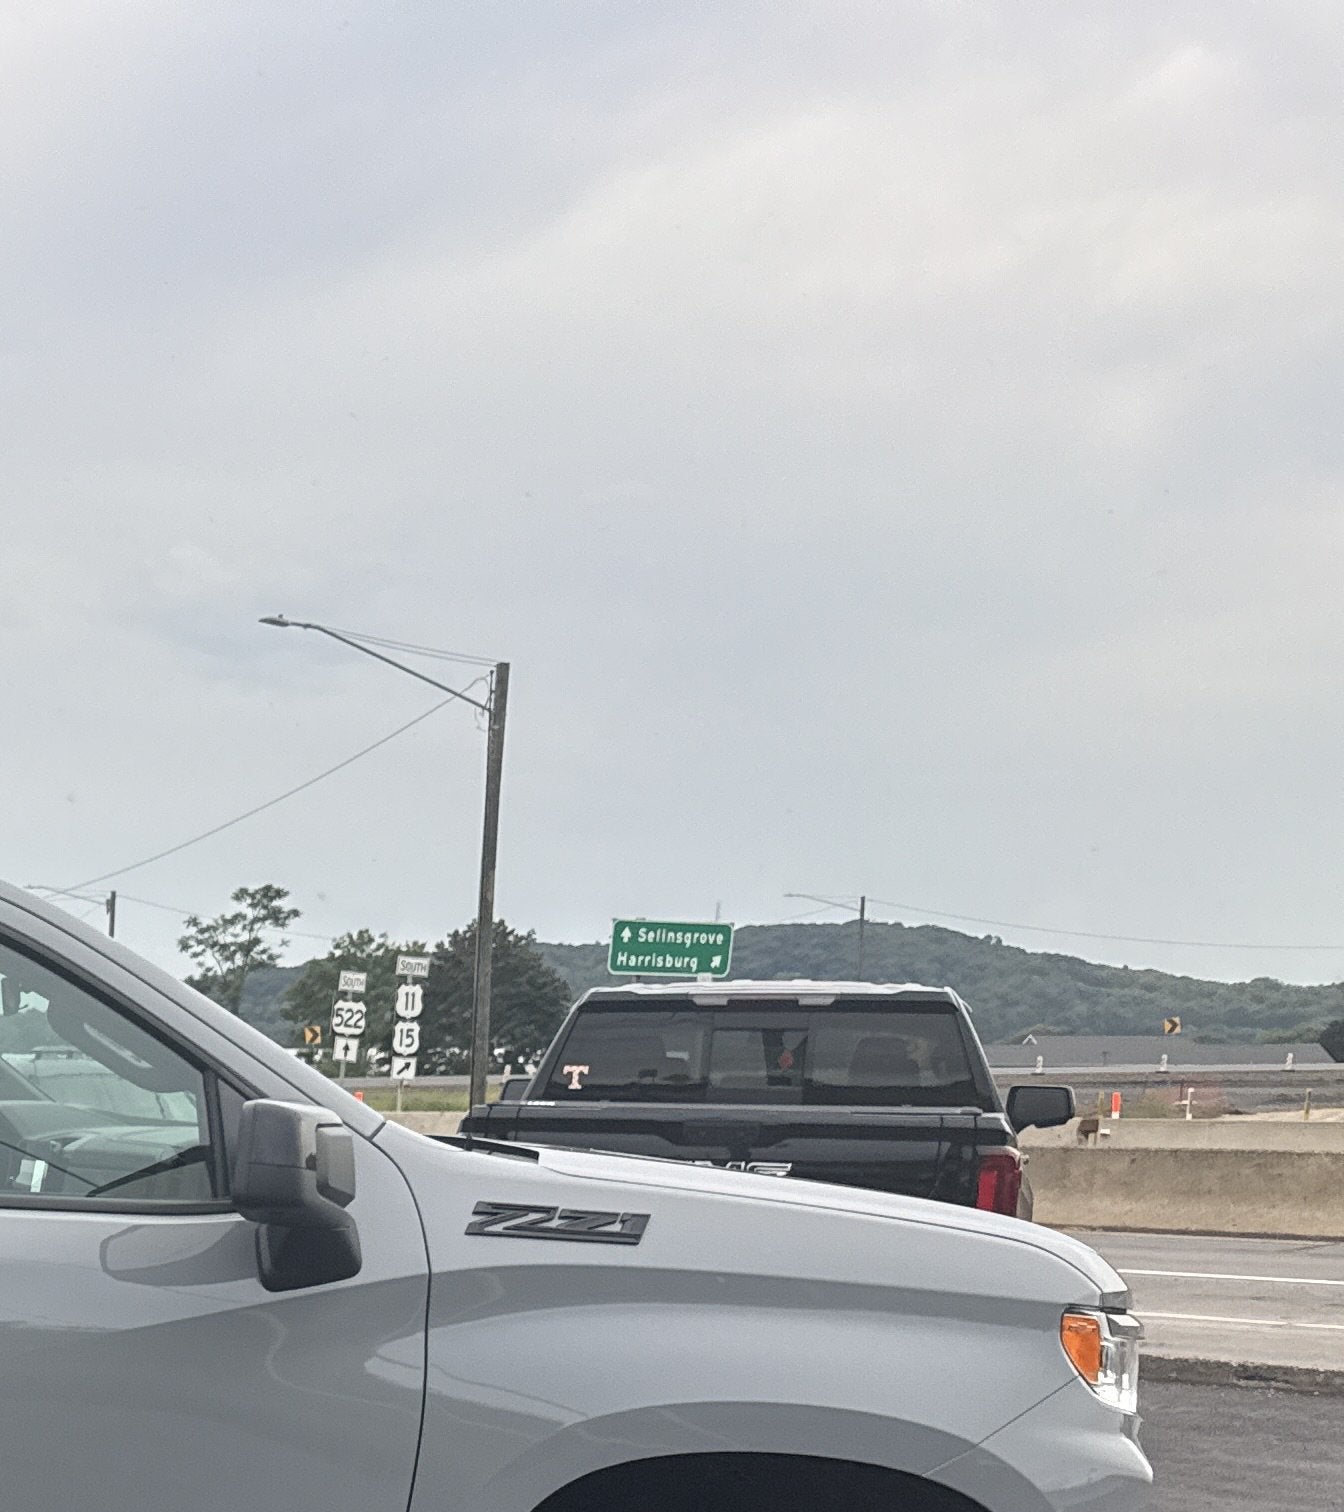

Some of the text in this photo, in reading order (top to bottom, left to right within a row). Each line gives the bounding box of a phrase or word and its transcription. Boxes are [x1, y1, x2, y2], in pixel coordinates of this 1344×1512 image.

[637, 927, 724, 949] Selinsgrove
[401, 959, 427, 973] SOUTH
[616, 951, 699, 973] Harrisburg
[341, 975, 366, 988] SOUTH
[404, 991, 416, 1012] 11
[334, 1007, 364, 1030] 522
[399, 1028, 415, 1048] 15
